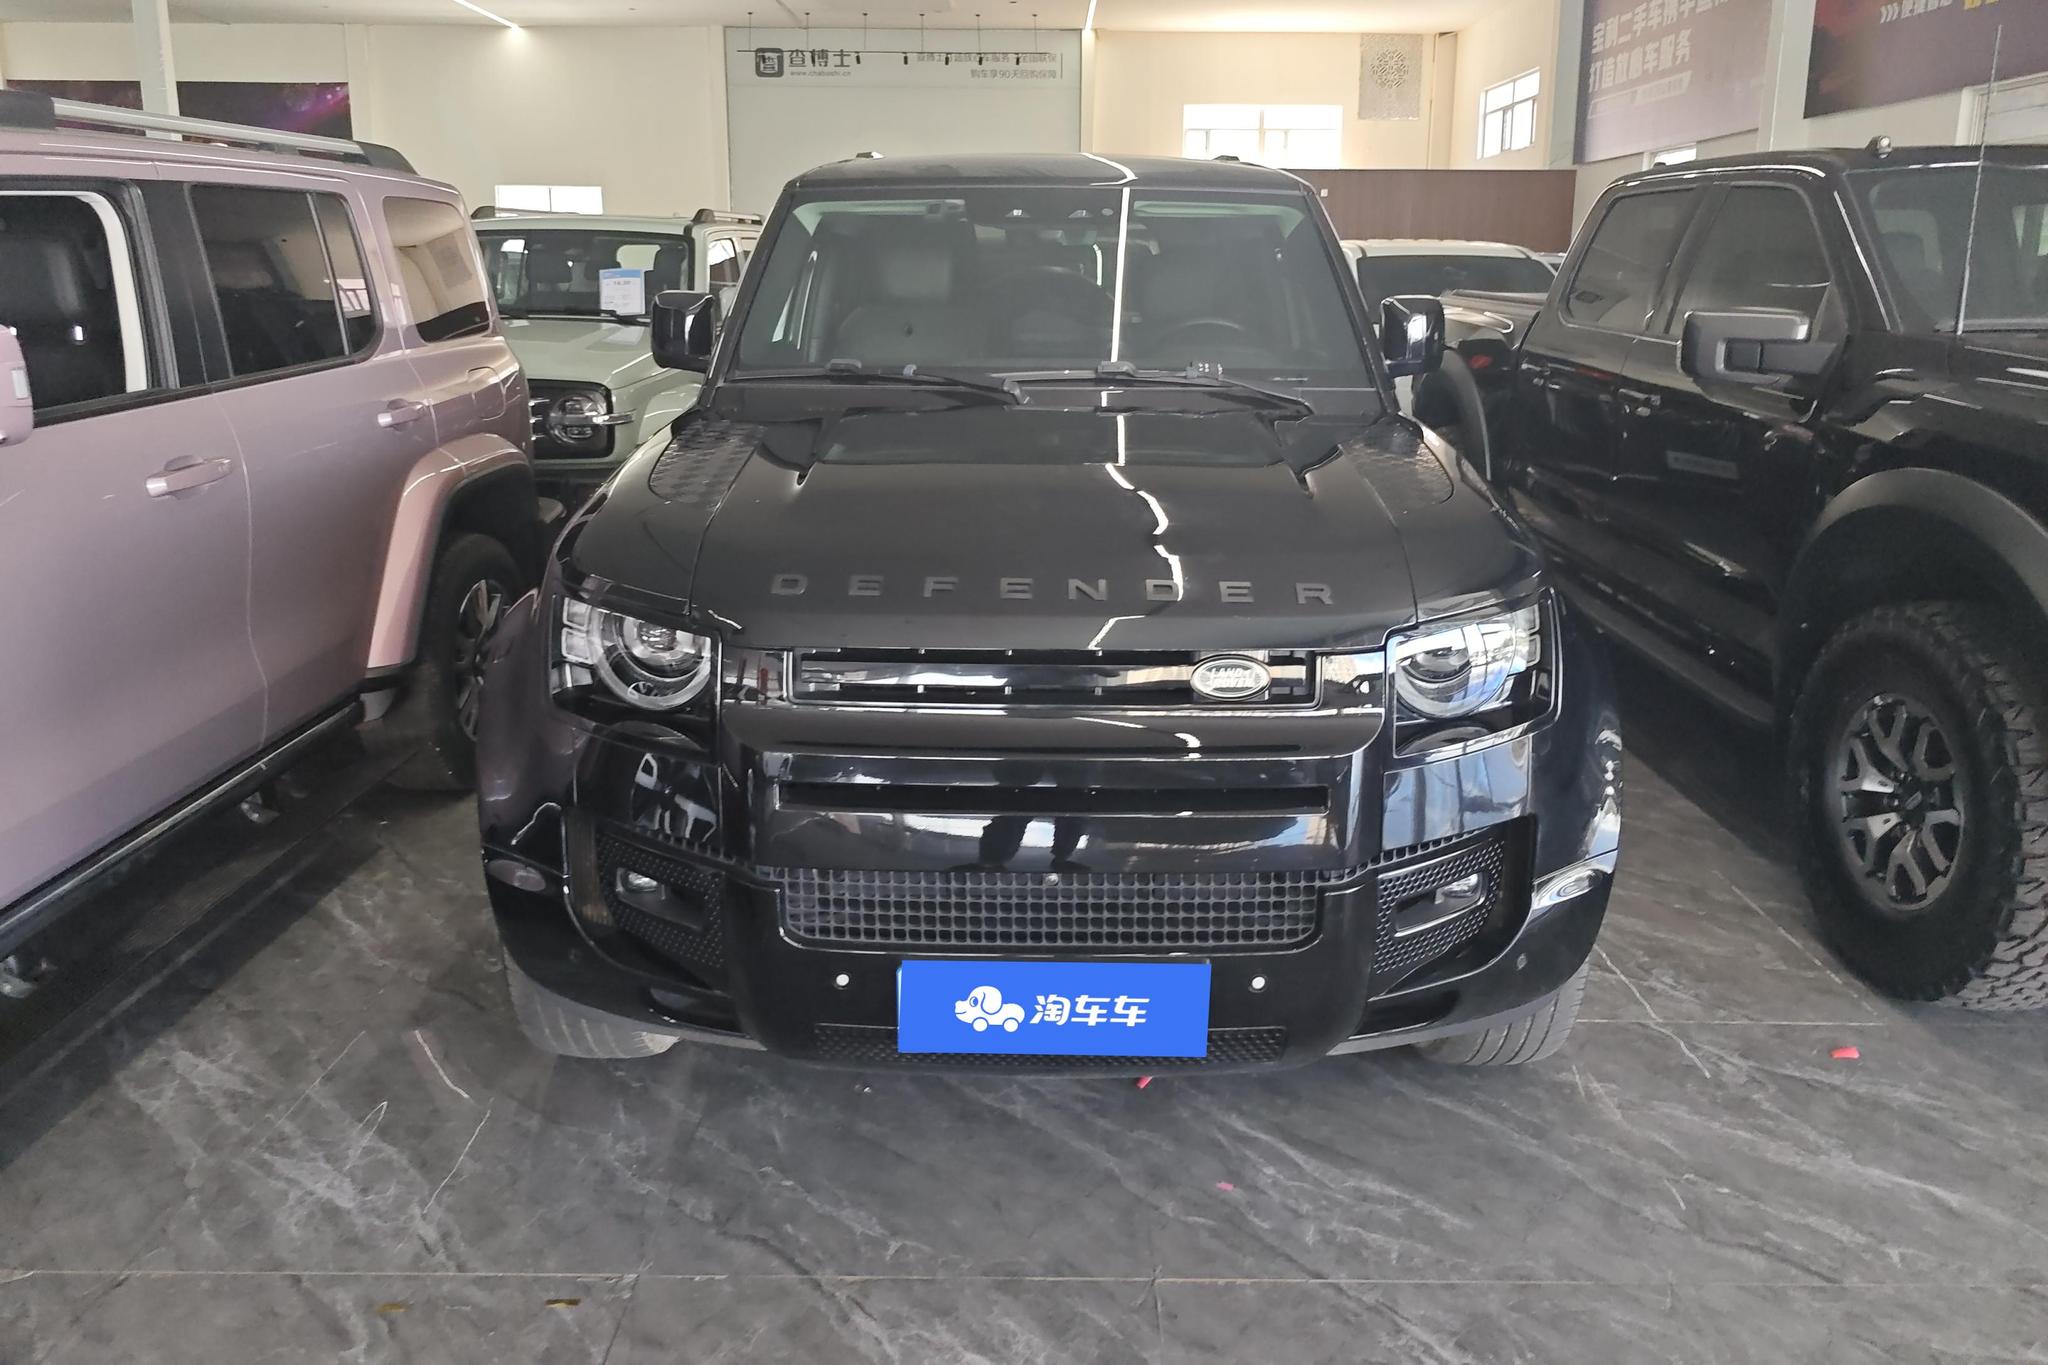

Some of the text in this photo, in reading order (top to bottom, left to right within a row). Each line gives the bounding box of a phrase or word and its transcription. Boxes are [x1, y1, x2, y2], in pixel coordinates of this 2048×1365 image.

[788, 48, 851, 67] 查博士
[770, 573, 1334, 605] DEFENDER
